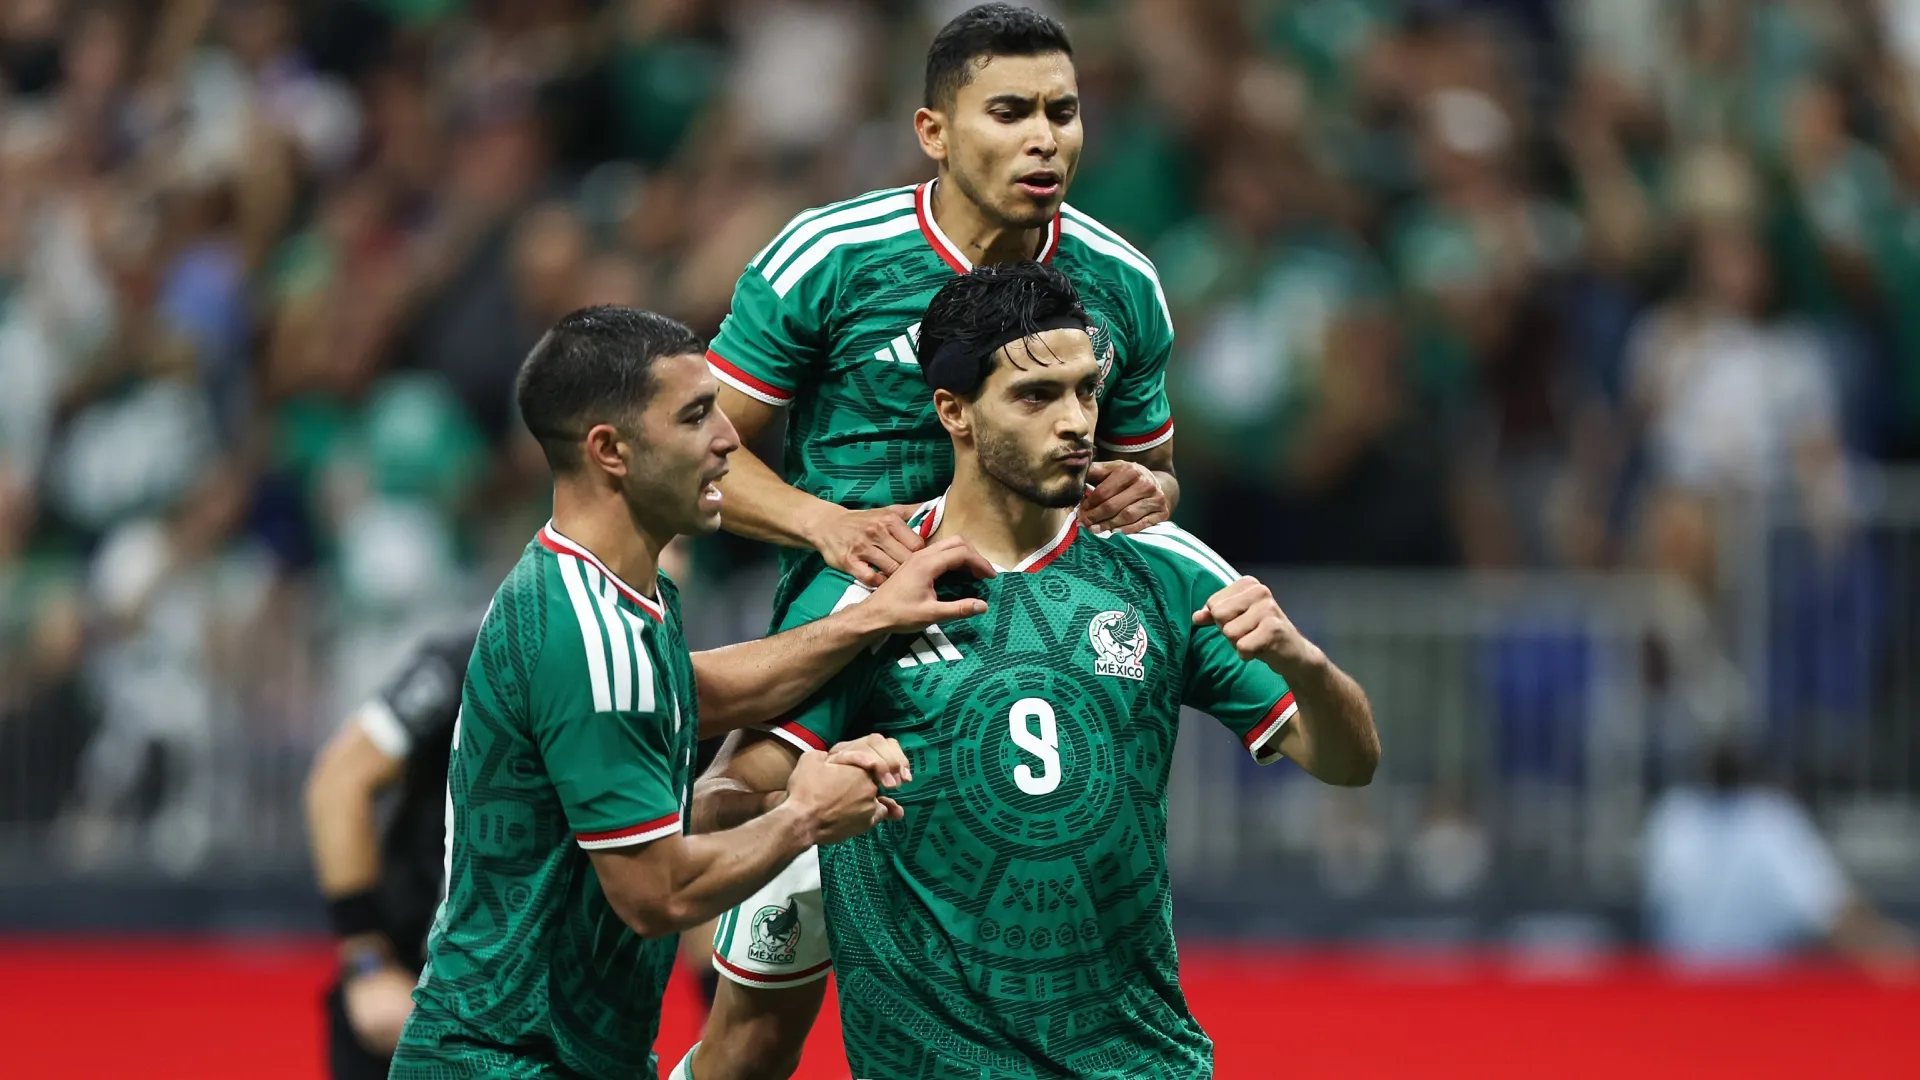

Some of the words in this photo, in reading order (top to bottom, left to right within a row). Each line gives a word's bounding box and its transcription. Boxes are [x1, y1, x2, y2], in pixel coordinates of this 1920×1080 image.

[1096, 661, 1143, 678] MÉXICO
[1009, 697, 1061, 795] 9
[750, 949, 793, 961] MÉXICO
